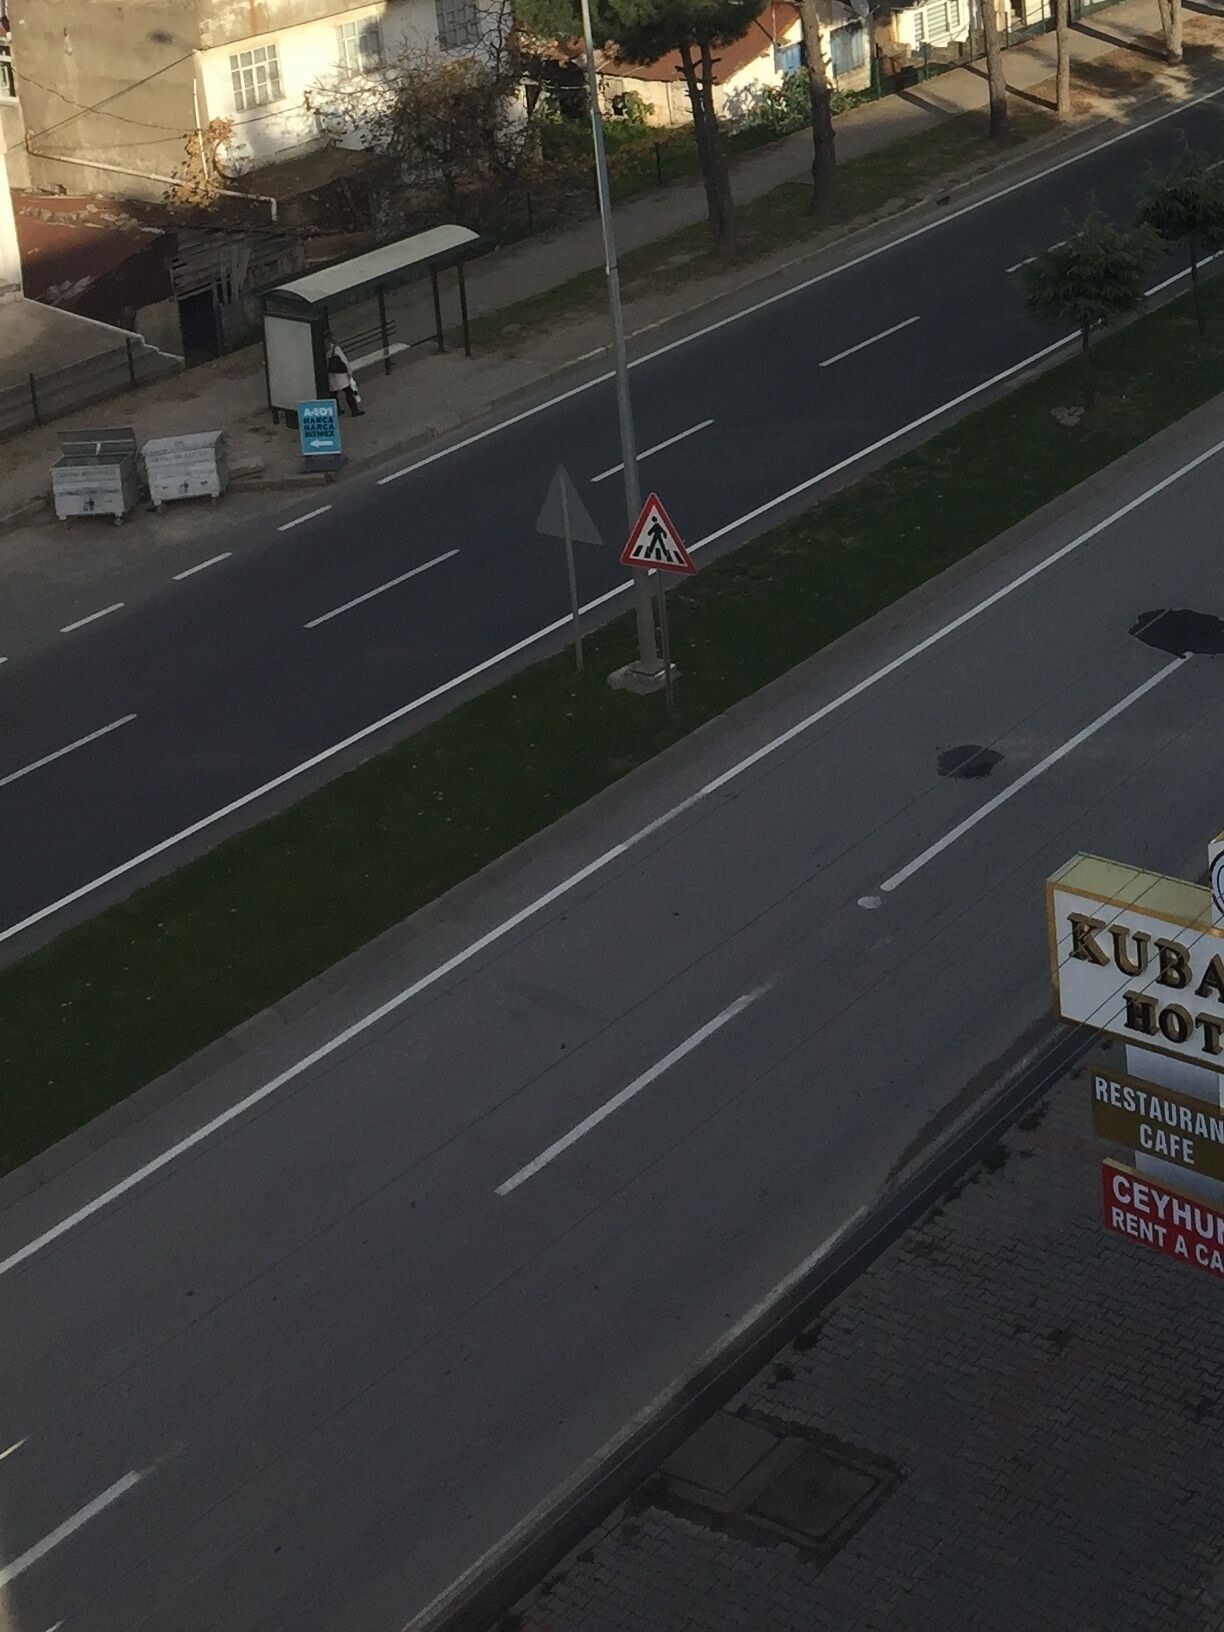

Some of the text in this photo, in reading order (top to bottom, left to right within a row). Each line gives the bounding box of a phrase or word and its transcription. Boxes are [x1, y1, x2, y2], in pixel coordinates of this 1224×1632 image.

[1139, 1123, 1195, 1165] CAFE
[1111, 1207, 1167, 1247] RENT
[1174, 1234, 1190, 1258] A
